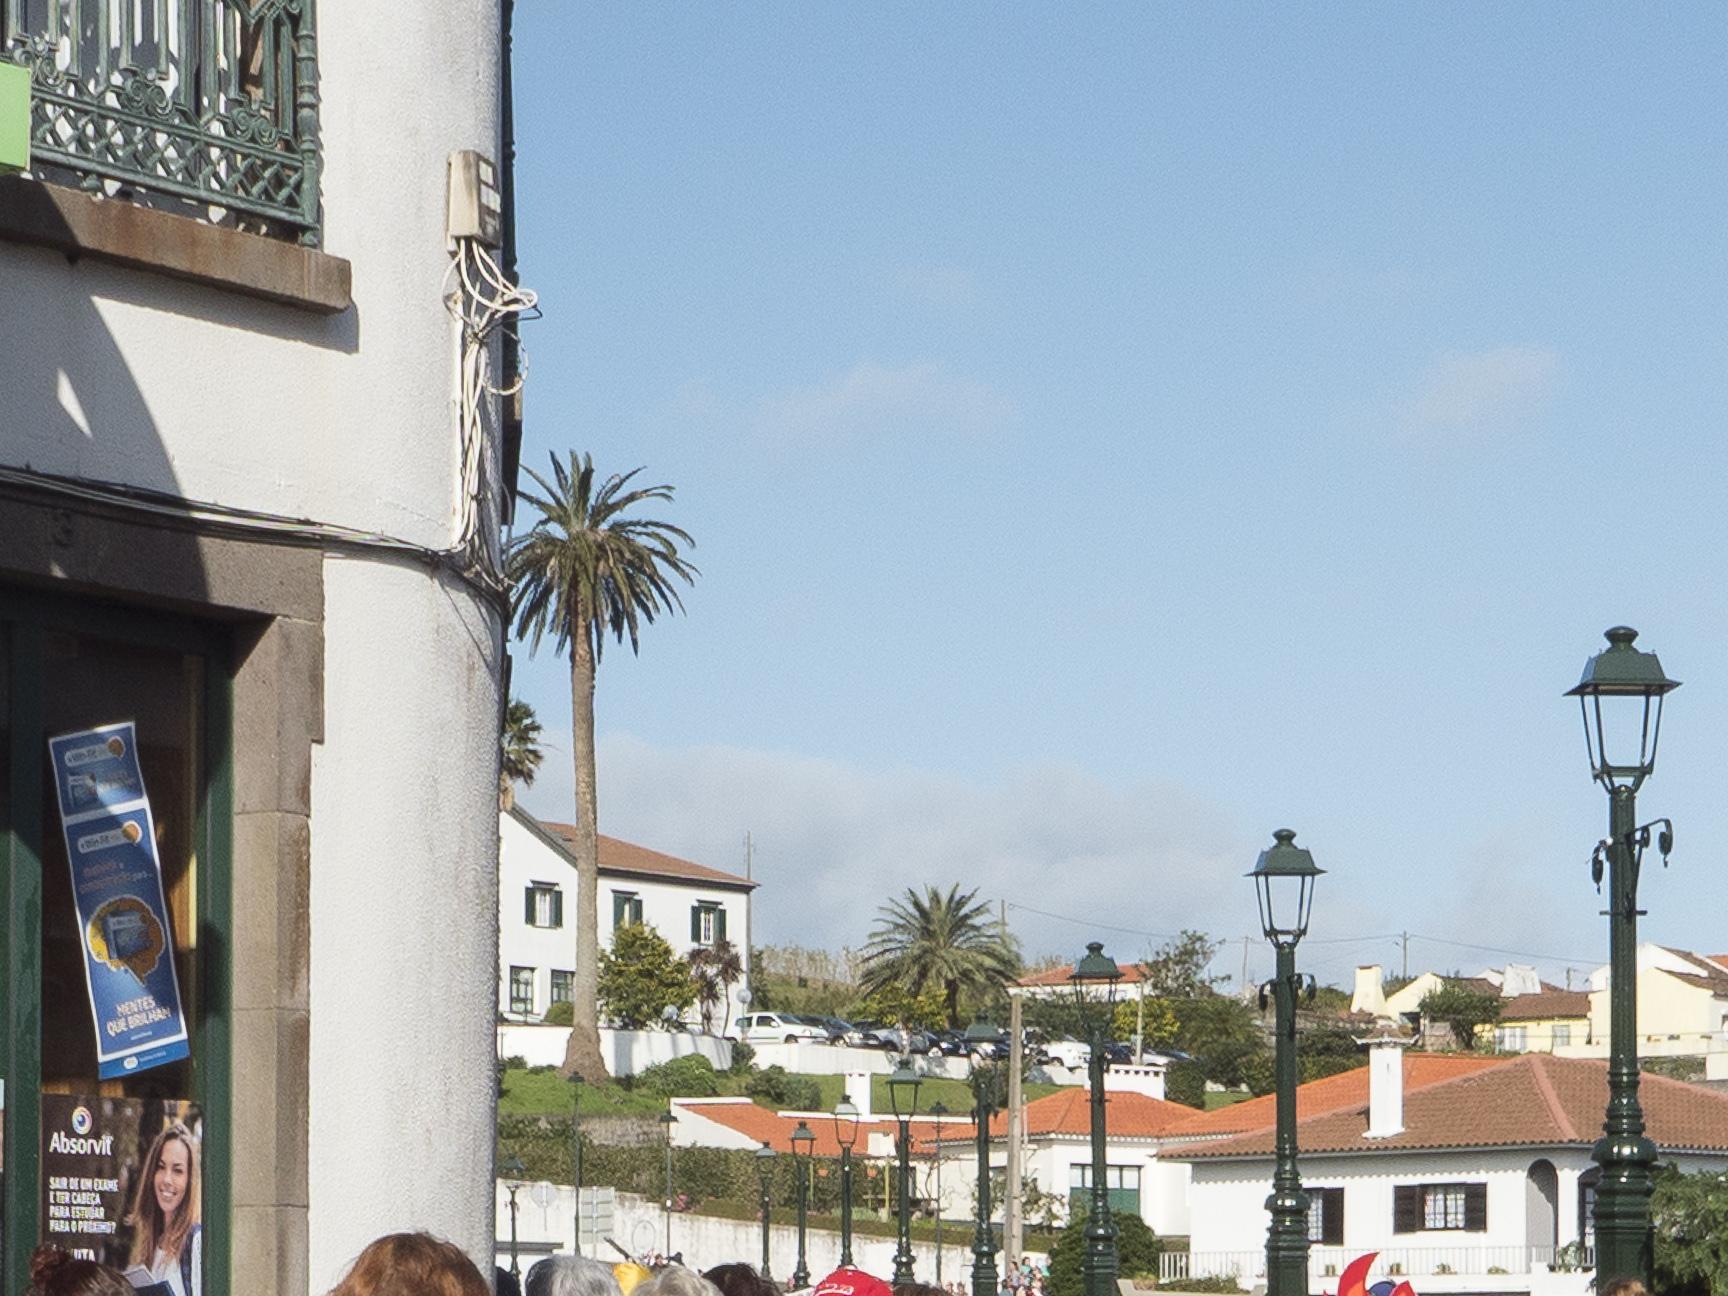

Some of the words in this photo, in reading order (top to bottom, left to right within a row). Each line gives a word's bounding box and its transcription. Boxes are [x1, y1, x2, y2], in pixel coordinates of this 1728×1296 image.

[49, 1130, 114, 1157] Absorvit
[49, 1205, 70, 1218] PARA
[49, 1219, 70, 1233] PARA
